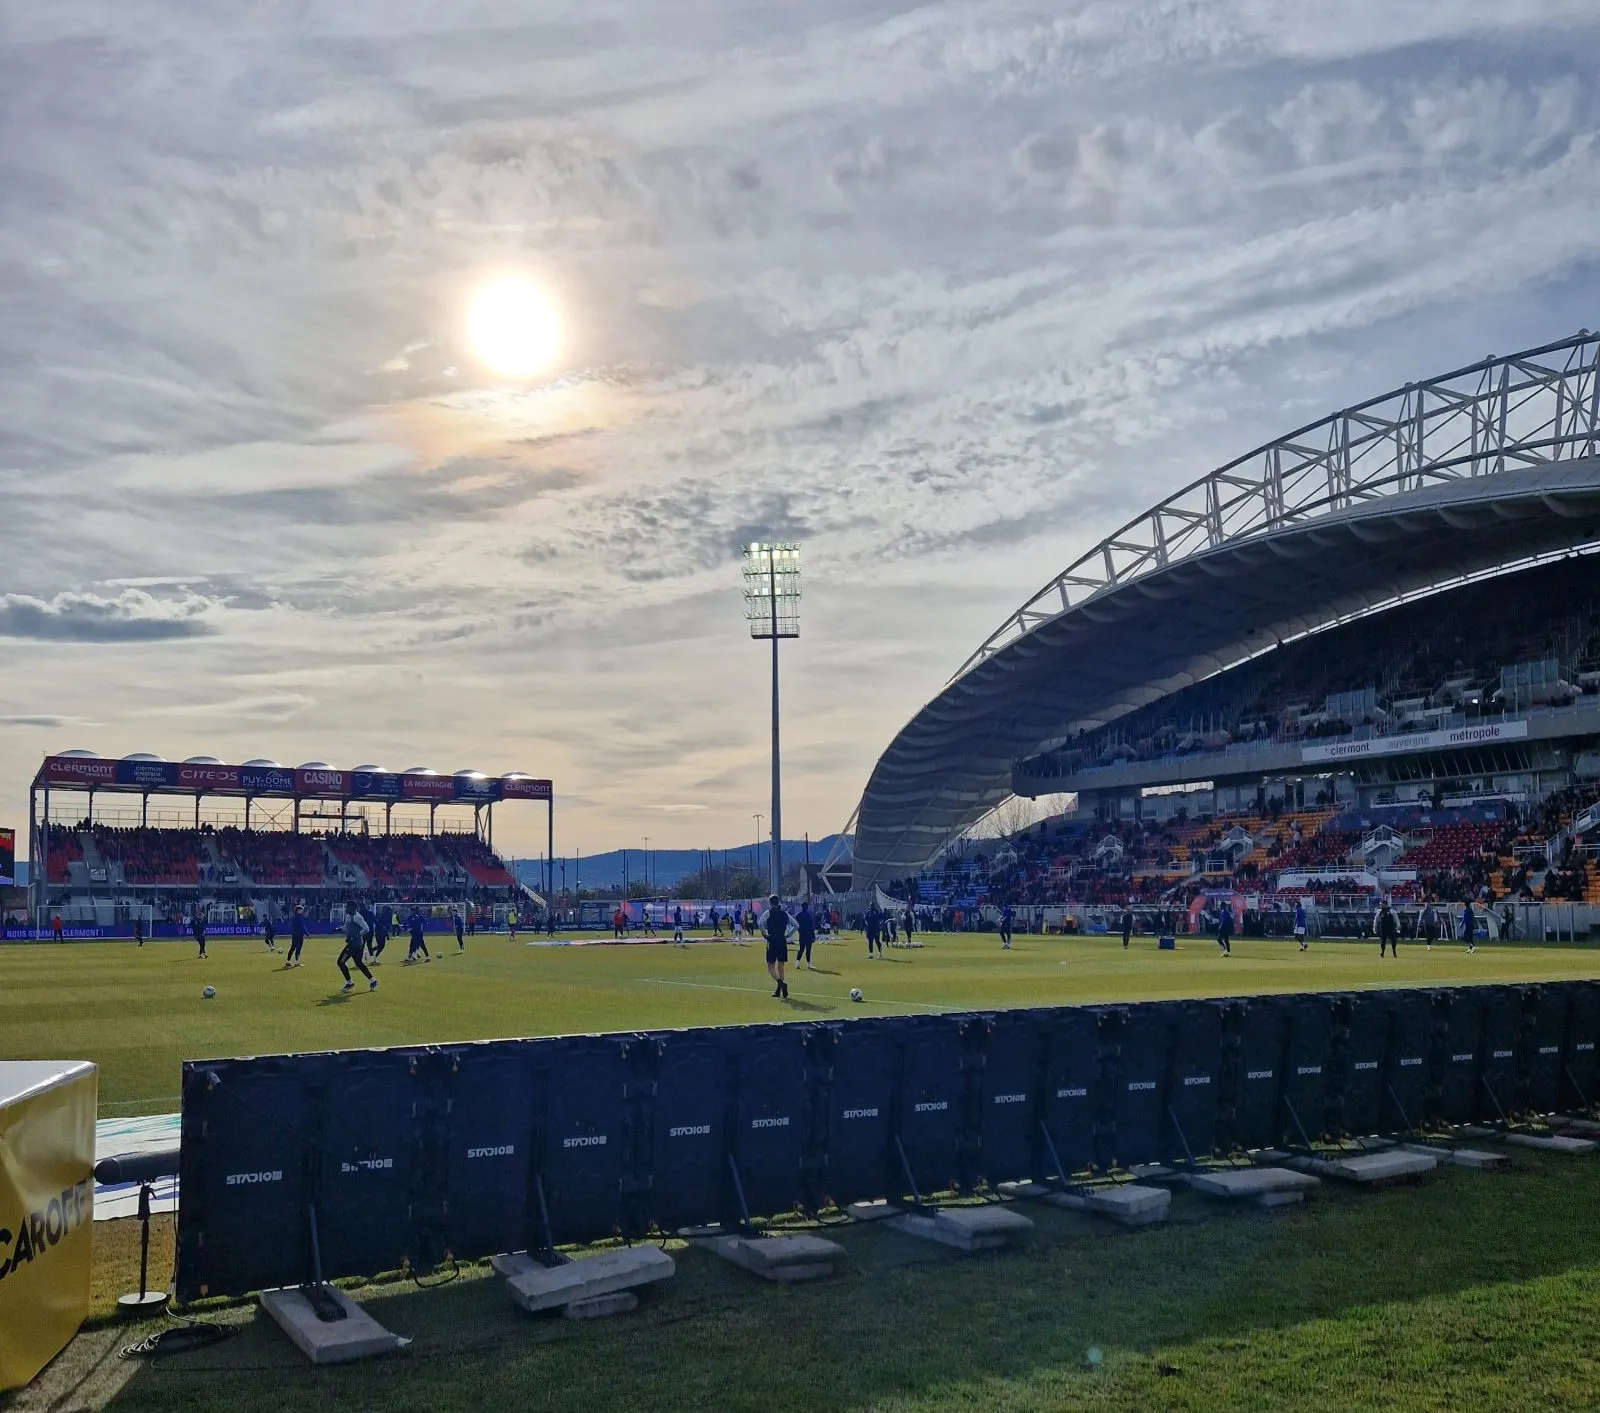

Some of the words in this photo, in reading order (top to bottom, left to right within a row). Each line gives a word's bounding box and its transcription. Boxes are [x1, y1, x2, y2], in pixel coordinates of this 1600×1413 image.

[1330, 742, 1370, 756] clermont
[1387, 735, 1430, 750] auvergne
[1449, 724, 1500, 742] métropole
[180, 769, 238, 782] CITEOS
[304, 772, 343, 785] CASINO
[404, 780, 413, 788] LA
[414, 781, 454, 790] MONTAGNE
[0, 1178, 88, 1281] CAROFF
